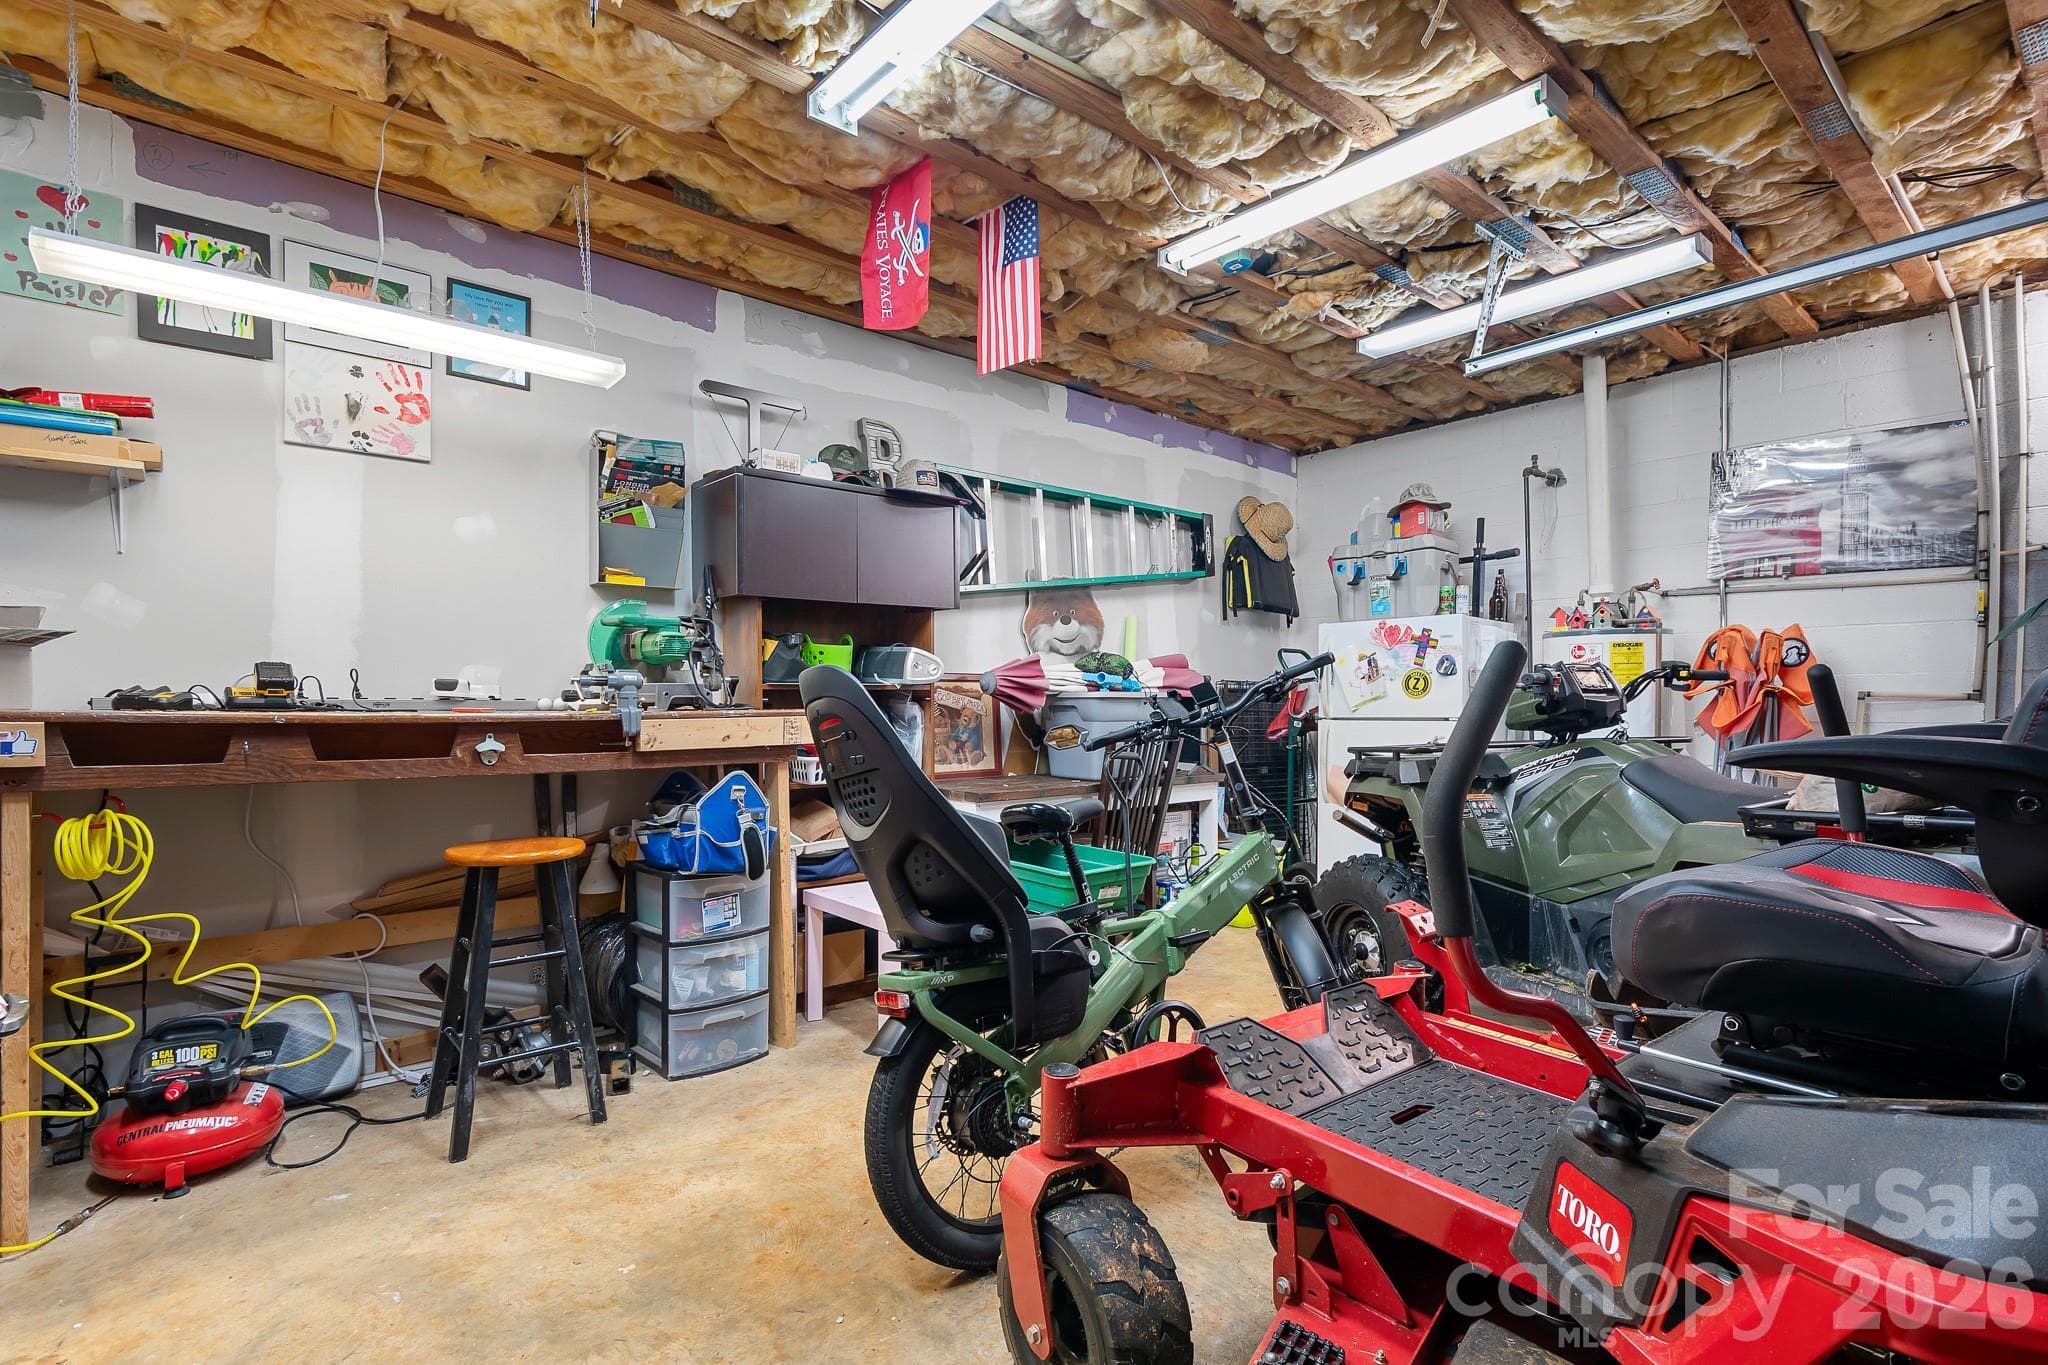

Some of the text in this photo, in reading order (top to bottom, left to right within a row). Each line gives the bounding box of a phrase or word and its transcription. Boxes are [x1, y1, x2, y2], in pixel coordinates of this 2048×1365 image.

[875, 254, 893, 319] VOYAGE
[613, 480, 650, 489] LONGER
[1412, 677, 1421, 691] Z
[1516, 755, 1575, 781] 570
[1227, 853, 1261, 885] LECTRIC
[151, 1051, 158, 1060] 3
[159, 1049, 174, 1059] GAL
[176, 1046, 200, 1064] 100
[200, 1047, 217, 1059] PSI
[1556, 1183, 1620, 1257] TORO
